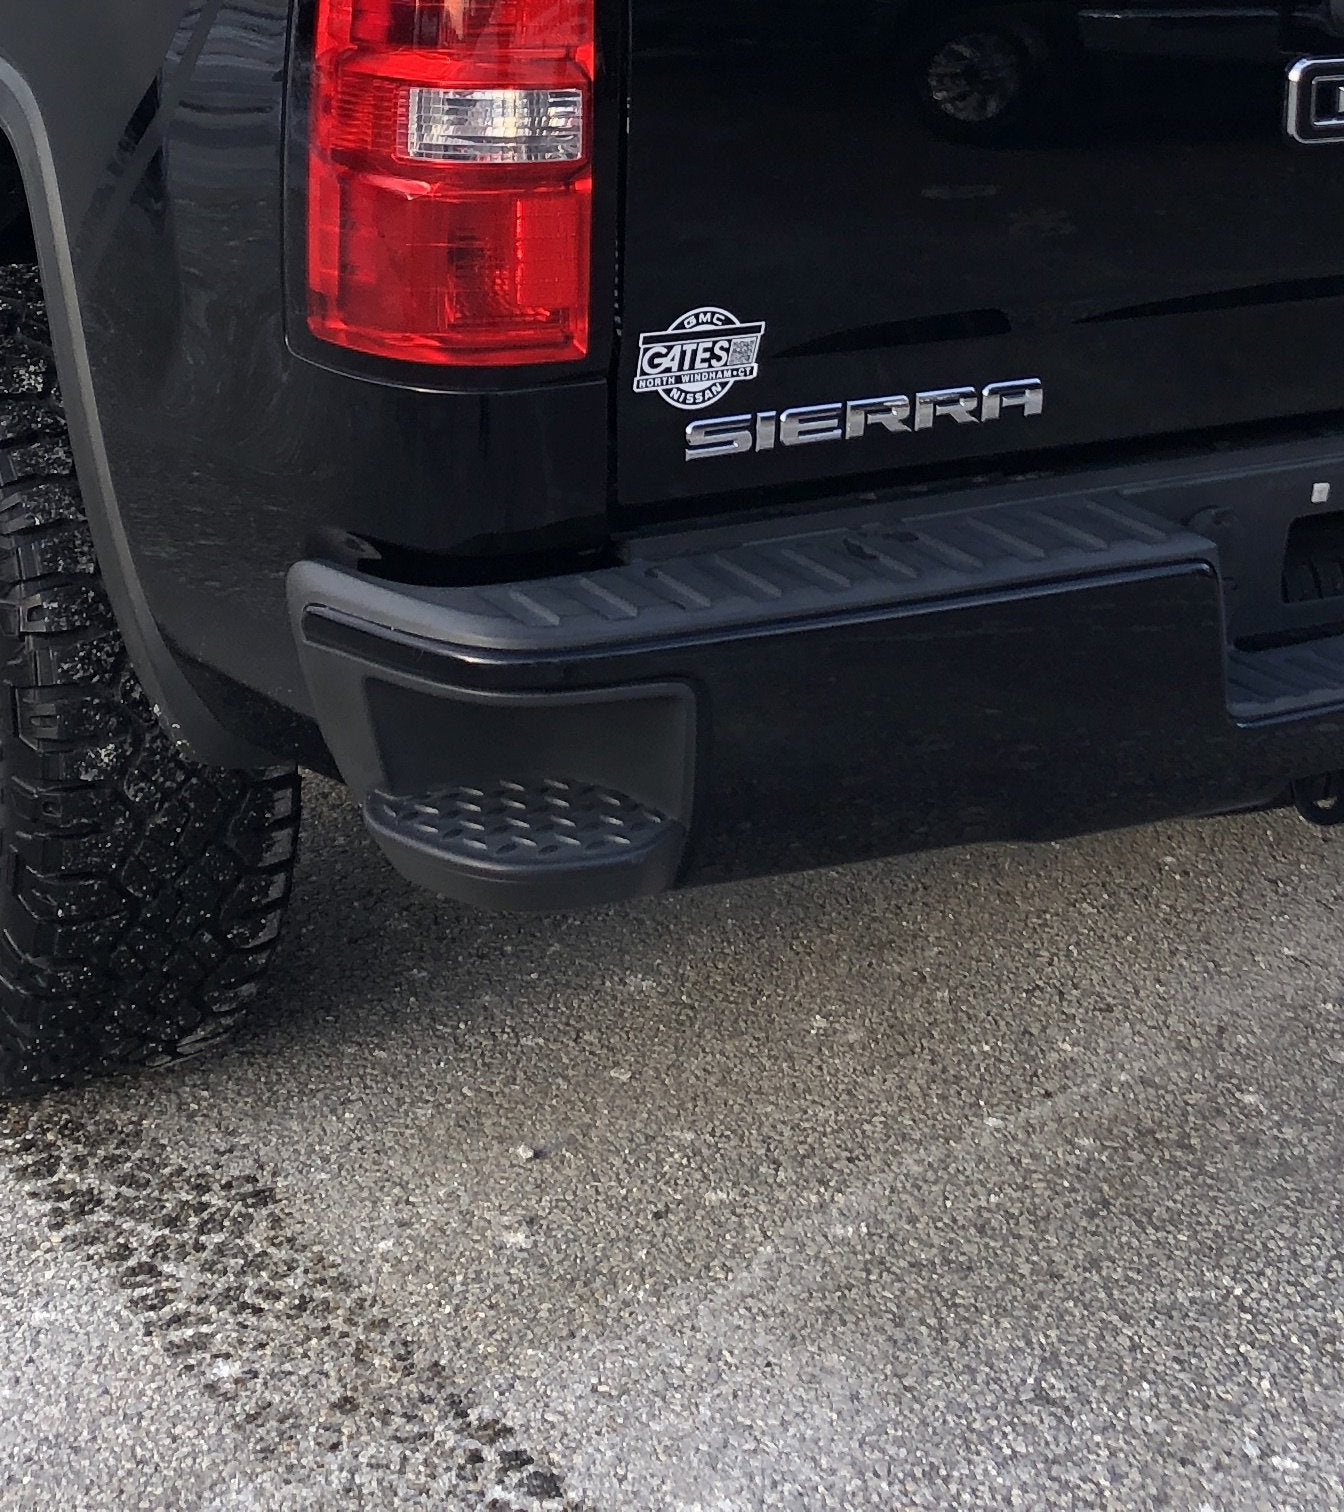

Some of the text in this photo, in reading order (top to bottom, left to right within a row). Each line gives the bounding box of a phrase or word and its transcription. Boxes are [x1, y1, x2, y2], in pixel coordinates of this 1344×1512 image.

[683, 312, 725, 328] GMC
[642, 340, 730, 374] GATES
[639, 376, 675, 388] NORTH
[669, 383, 723, 404] NISSAN
[685, 377, 1043, 462] SIERRA
